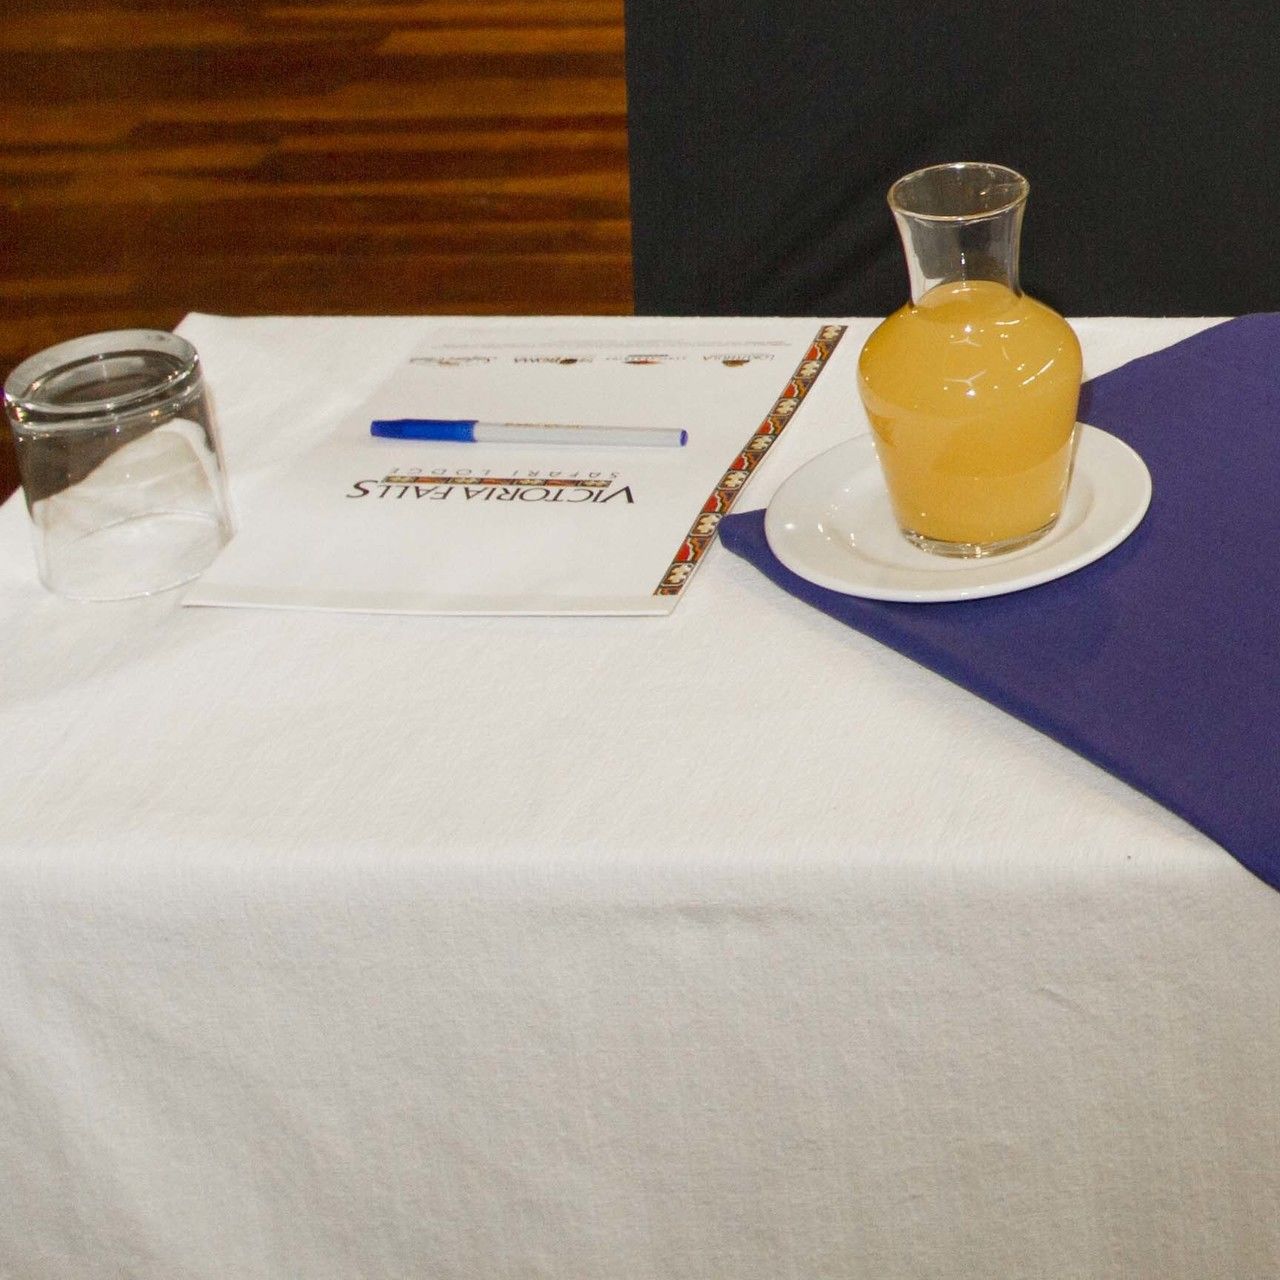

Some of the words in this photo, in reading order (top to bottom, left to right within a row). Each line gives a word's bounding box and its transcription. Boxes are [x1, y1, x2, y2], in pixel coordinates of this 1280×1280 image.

[388, 467, 491, 477] LODGE
[510, 469, 621, 479] SAFARI
[346, 479, 454, 501] FALLS
[462, 485, 635, 504] VICTORIA
